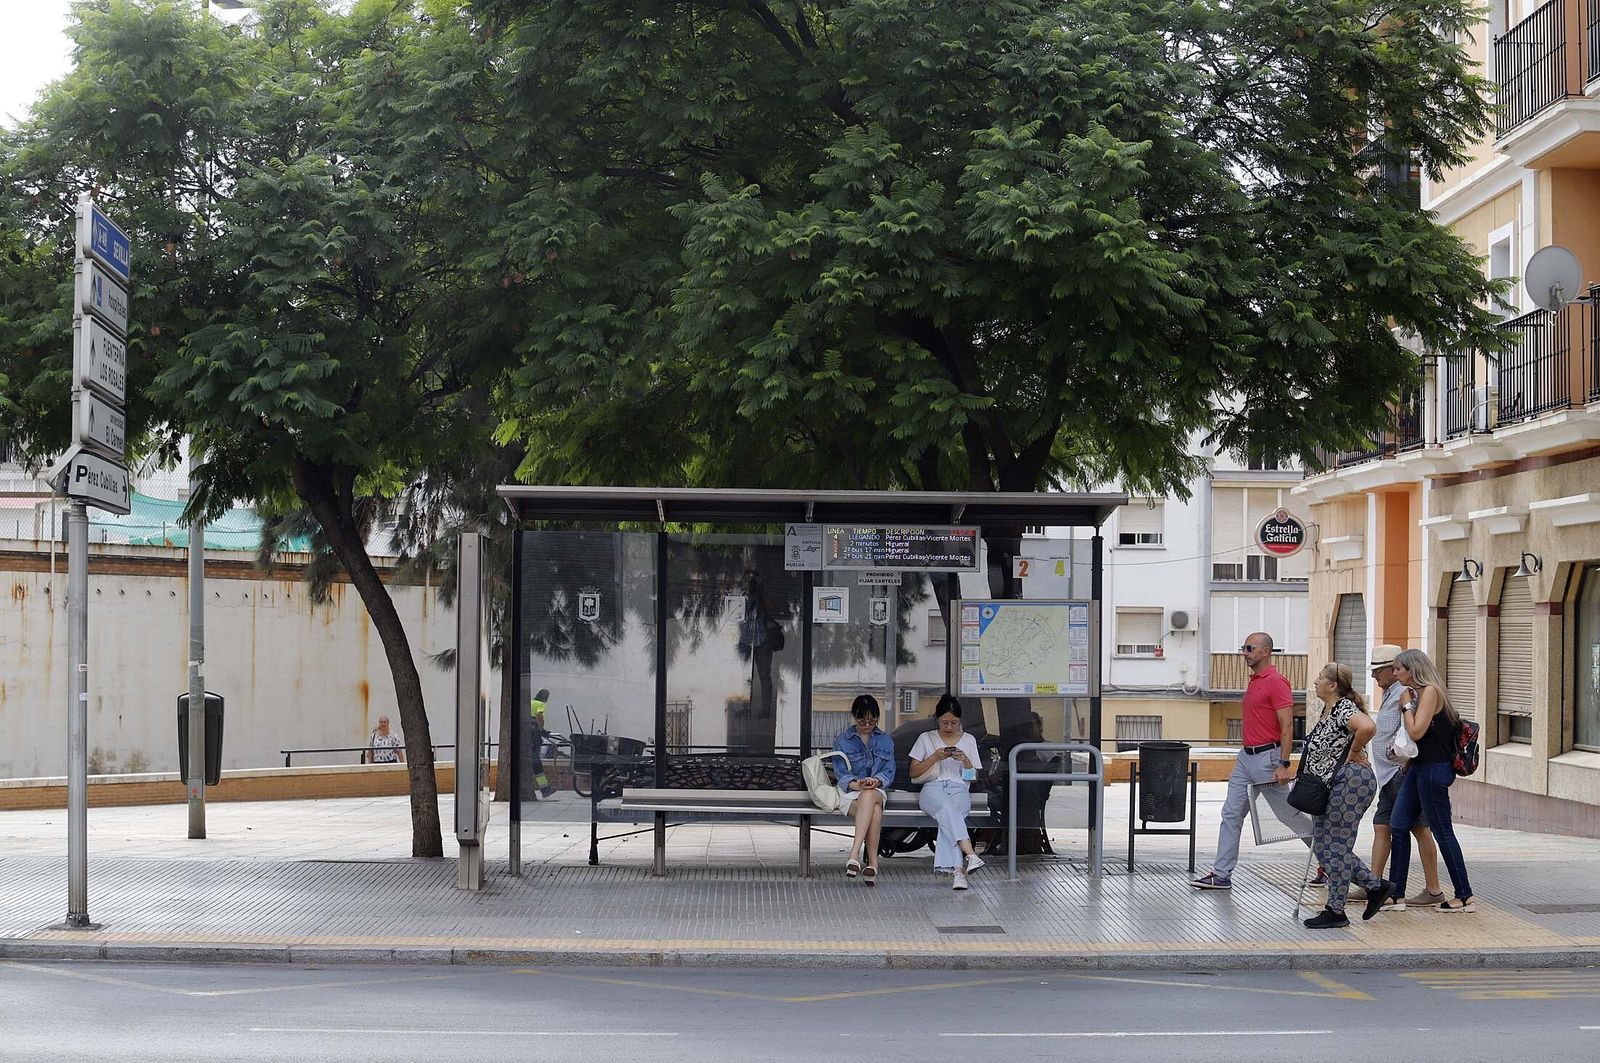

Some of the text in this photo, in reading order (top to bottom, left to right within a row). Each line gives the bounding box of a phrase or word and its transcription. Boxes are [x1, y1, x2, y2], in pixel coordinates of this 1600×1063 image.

[113, 240, 128, 265] SEVILLA
[108, 290, 127, 319] hospitales
[99, 362, 124, 393] LOS ROSALES
[105, 425, 110, 442] El
[100, 470, 118, 494] Cubillas
[1265, 524, 1299, 534] Estrella
[1266, 533, 1297, 543] Galicia
[1019, 560, 1029, 576] 2
[1055, 560, 1065, 576] 4
